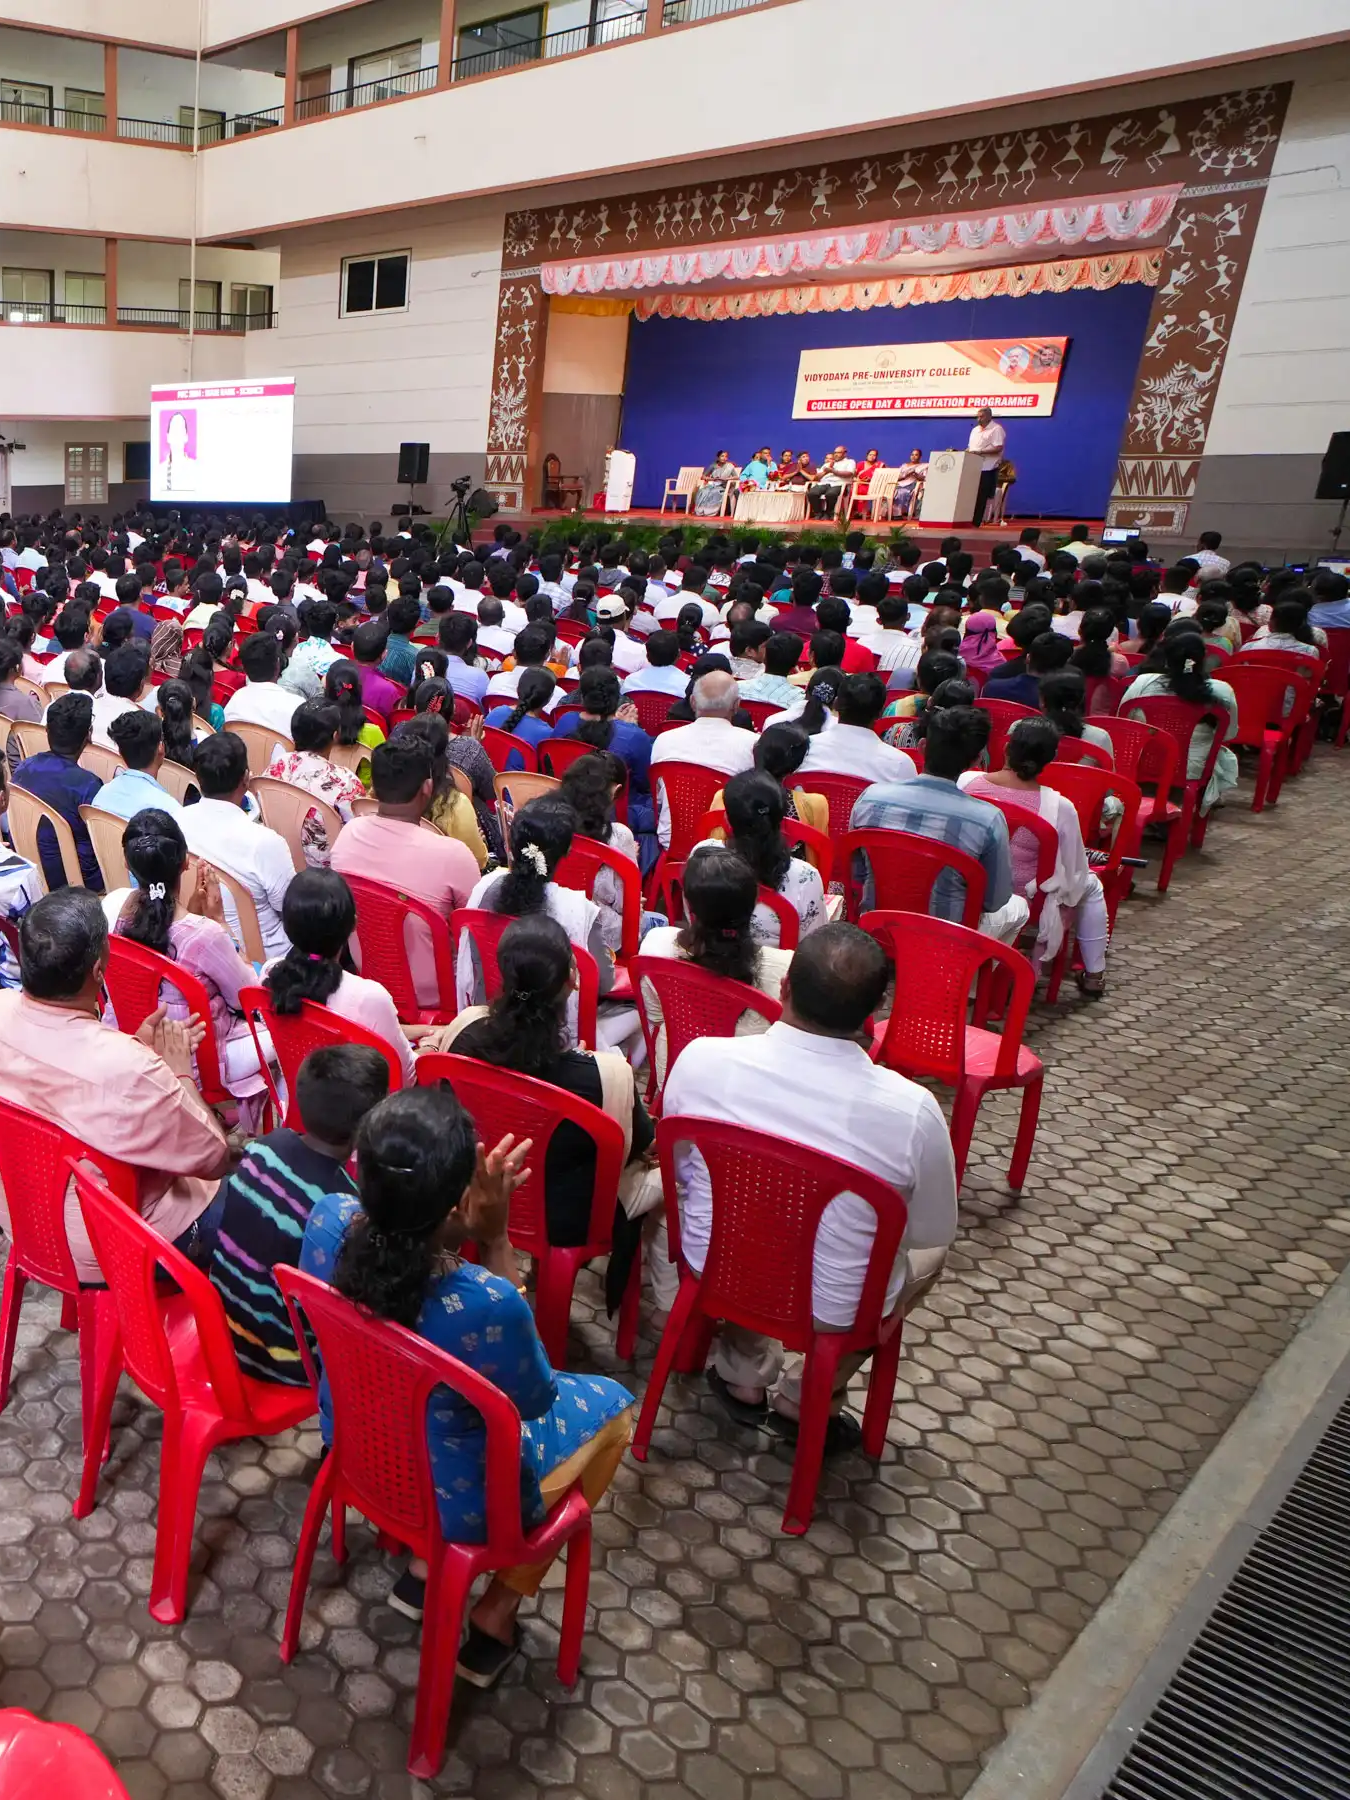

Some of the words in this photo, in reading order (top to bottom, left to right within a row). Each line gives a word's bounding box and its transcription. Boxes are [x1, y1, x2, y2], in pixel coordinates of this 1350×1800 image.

[804, 371, 850, 383] VIDYODAYA
[852, 368, 927, 381] PRE-UNIVERSITY
[929, 366, 972, 378] COLLEGE
[811, 400, 848, 410] COLLEGE
[850, 399, 873, 409] OPEN
[875, 398, 894, 409] DAY
[894, 398, 902, 408] &
[904, 397, 968, 408] ORIENTATION
[969, 395, 1035, 407] PROGRAMME
